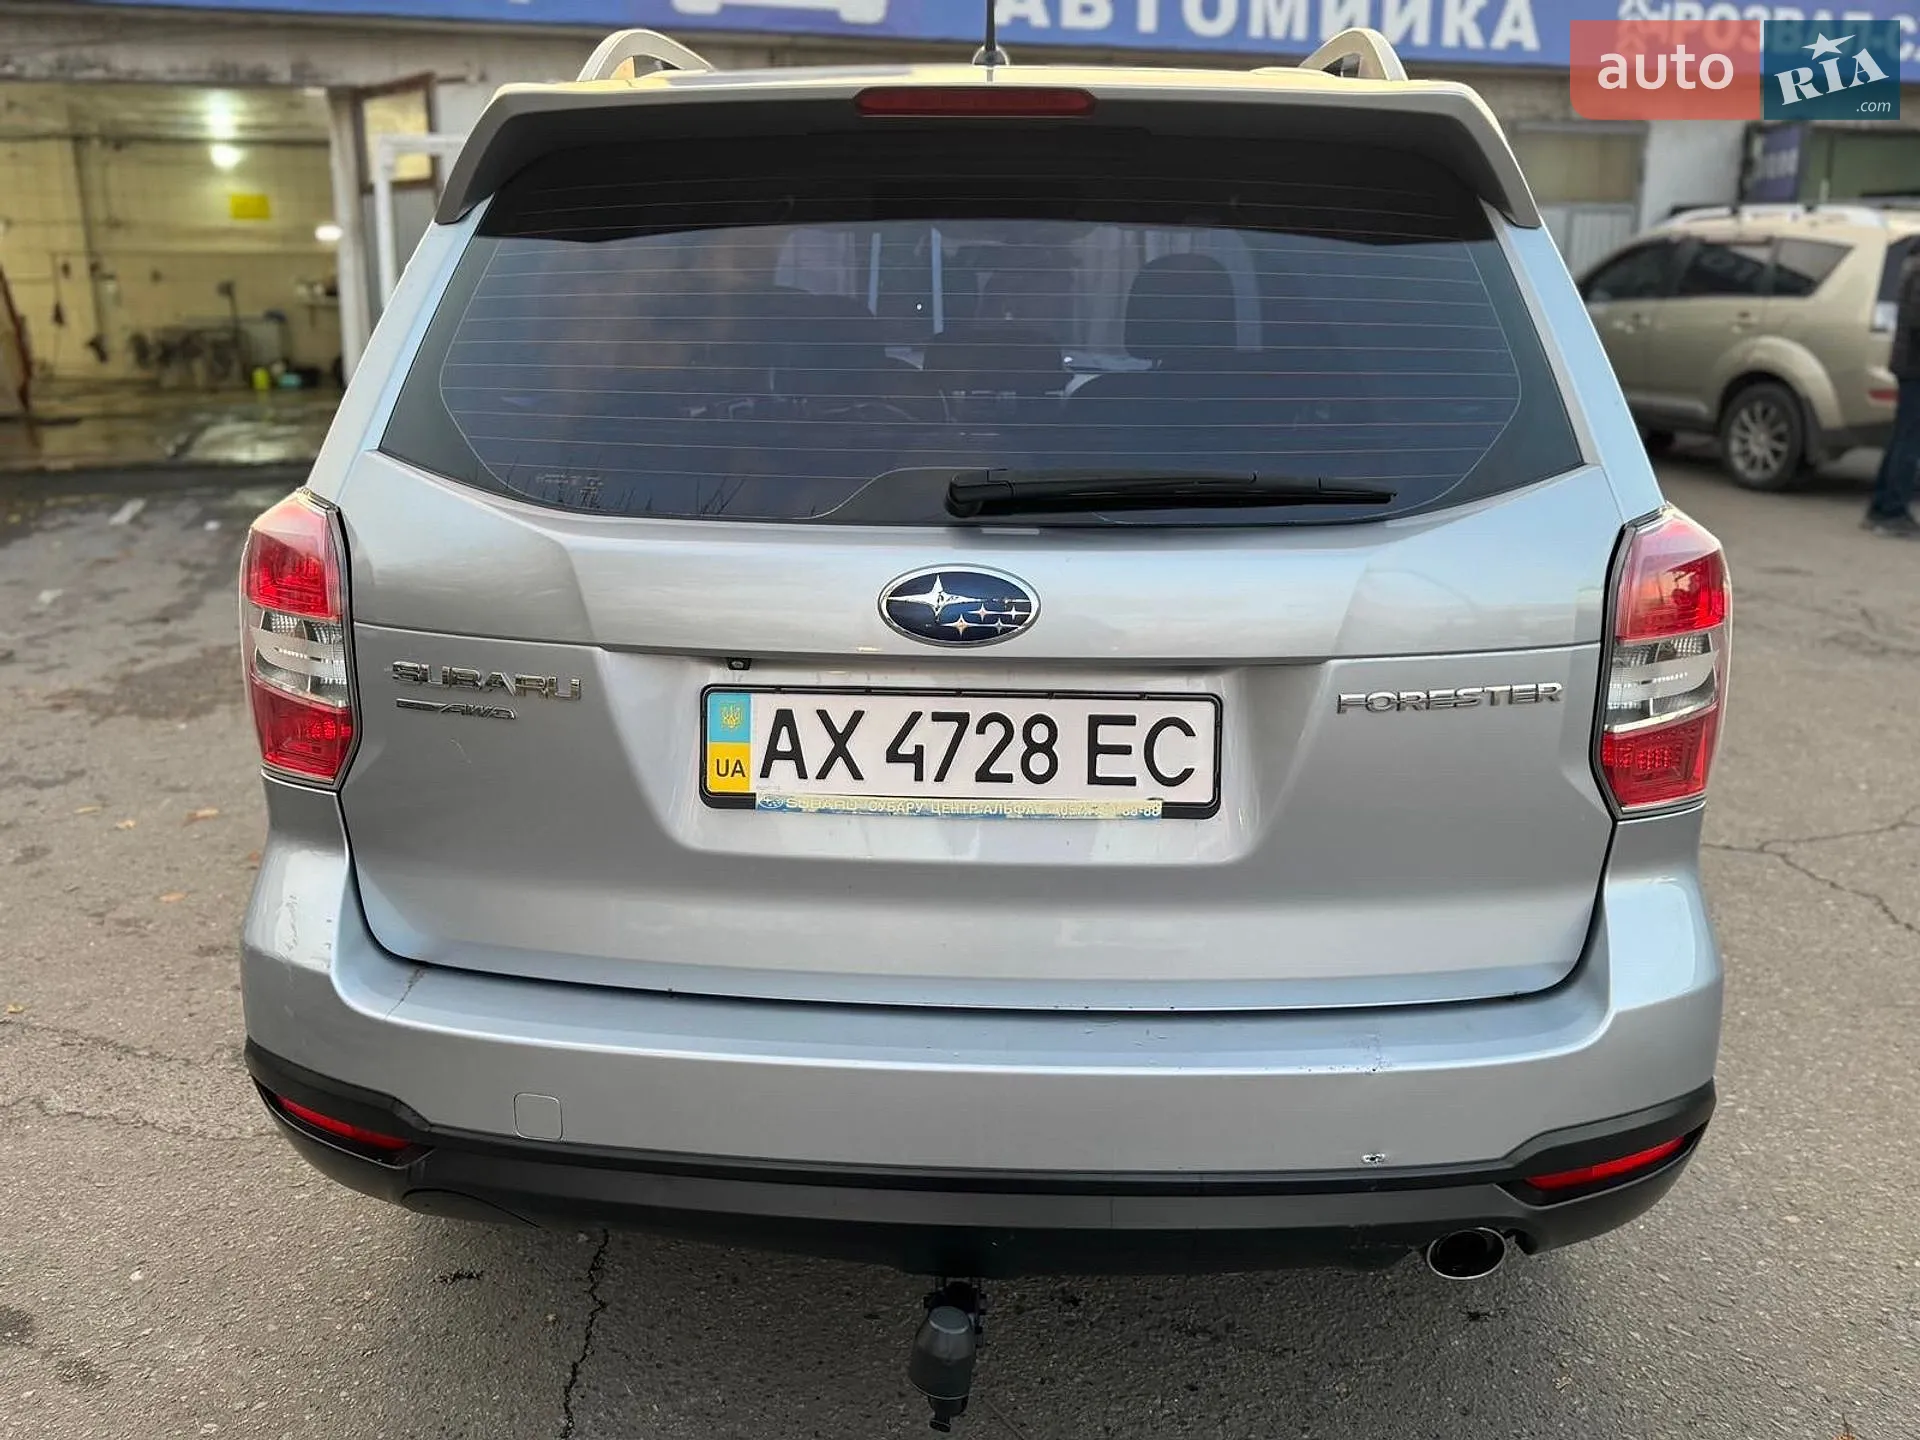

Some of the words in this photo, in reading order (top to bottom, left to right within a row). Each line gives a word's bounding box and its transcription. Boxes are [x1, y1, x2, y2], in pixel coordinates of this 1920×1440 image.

[392, 661, 581, 700] SUBARU
[1337, 682, 1563, 714] FORESTER
[760, 708, 865, 781] AX
[885, 711, 1059, 785] 4728
[1087, 714, 1197, 787] EC
[715, 759, 746, 778] UA
